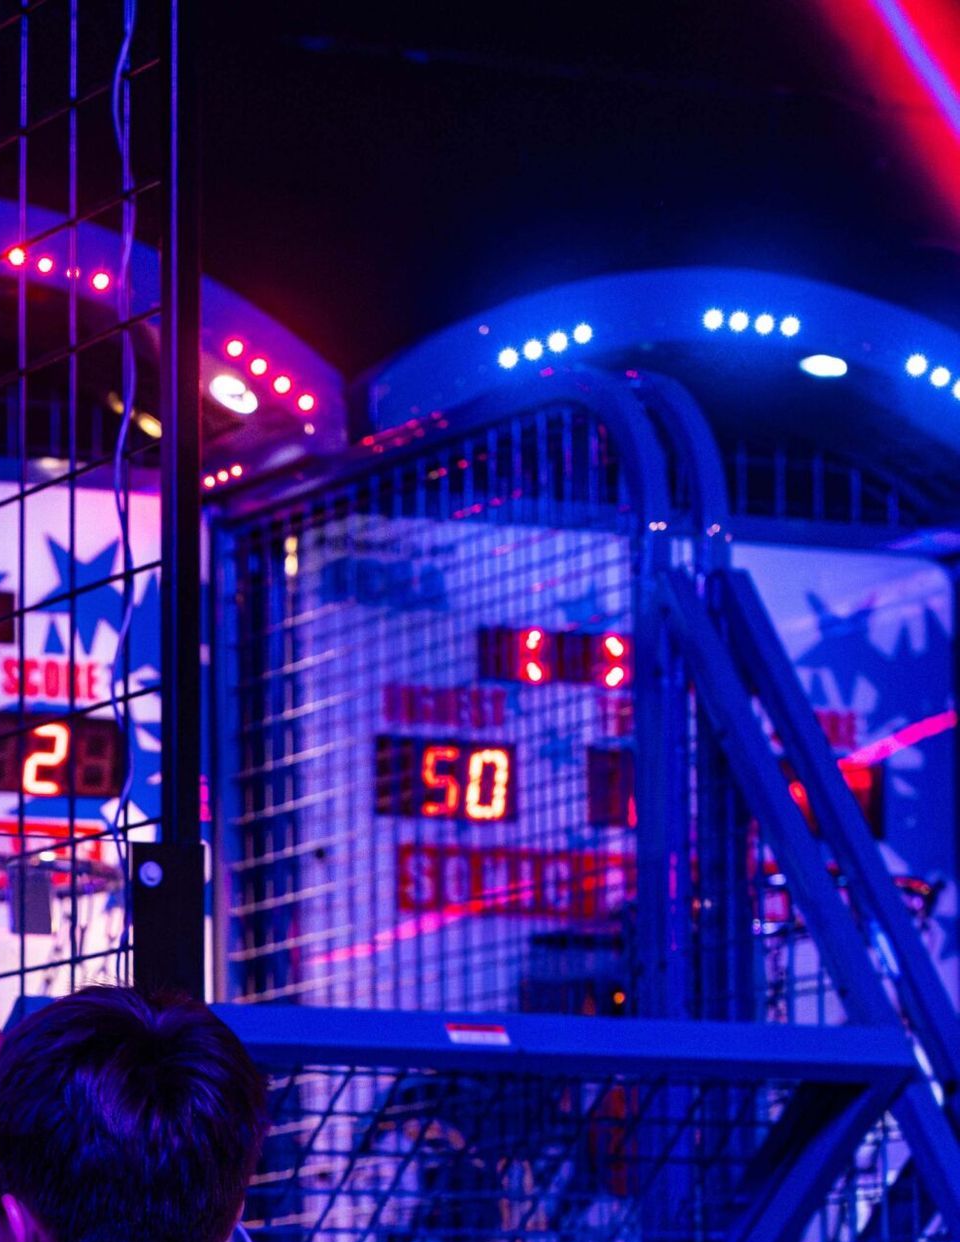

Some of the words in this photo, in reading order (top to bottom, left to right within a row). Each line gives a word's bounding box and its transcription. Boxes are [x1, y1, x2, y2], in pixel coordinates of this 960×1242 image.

[1, 657, 99, 700] SCORE
[22, 721, 70, 796] 2
[421, 746, 509, 820] 50
